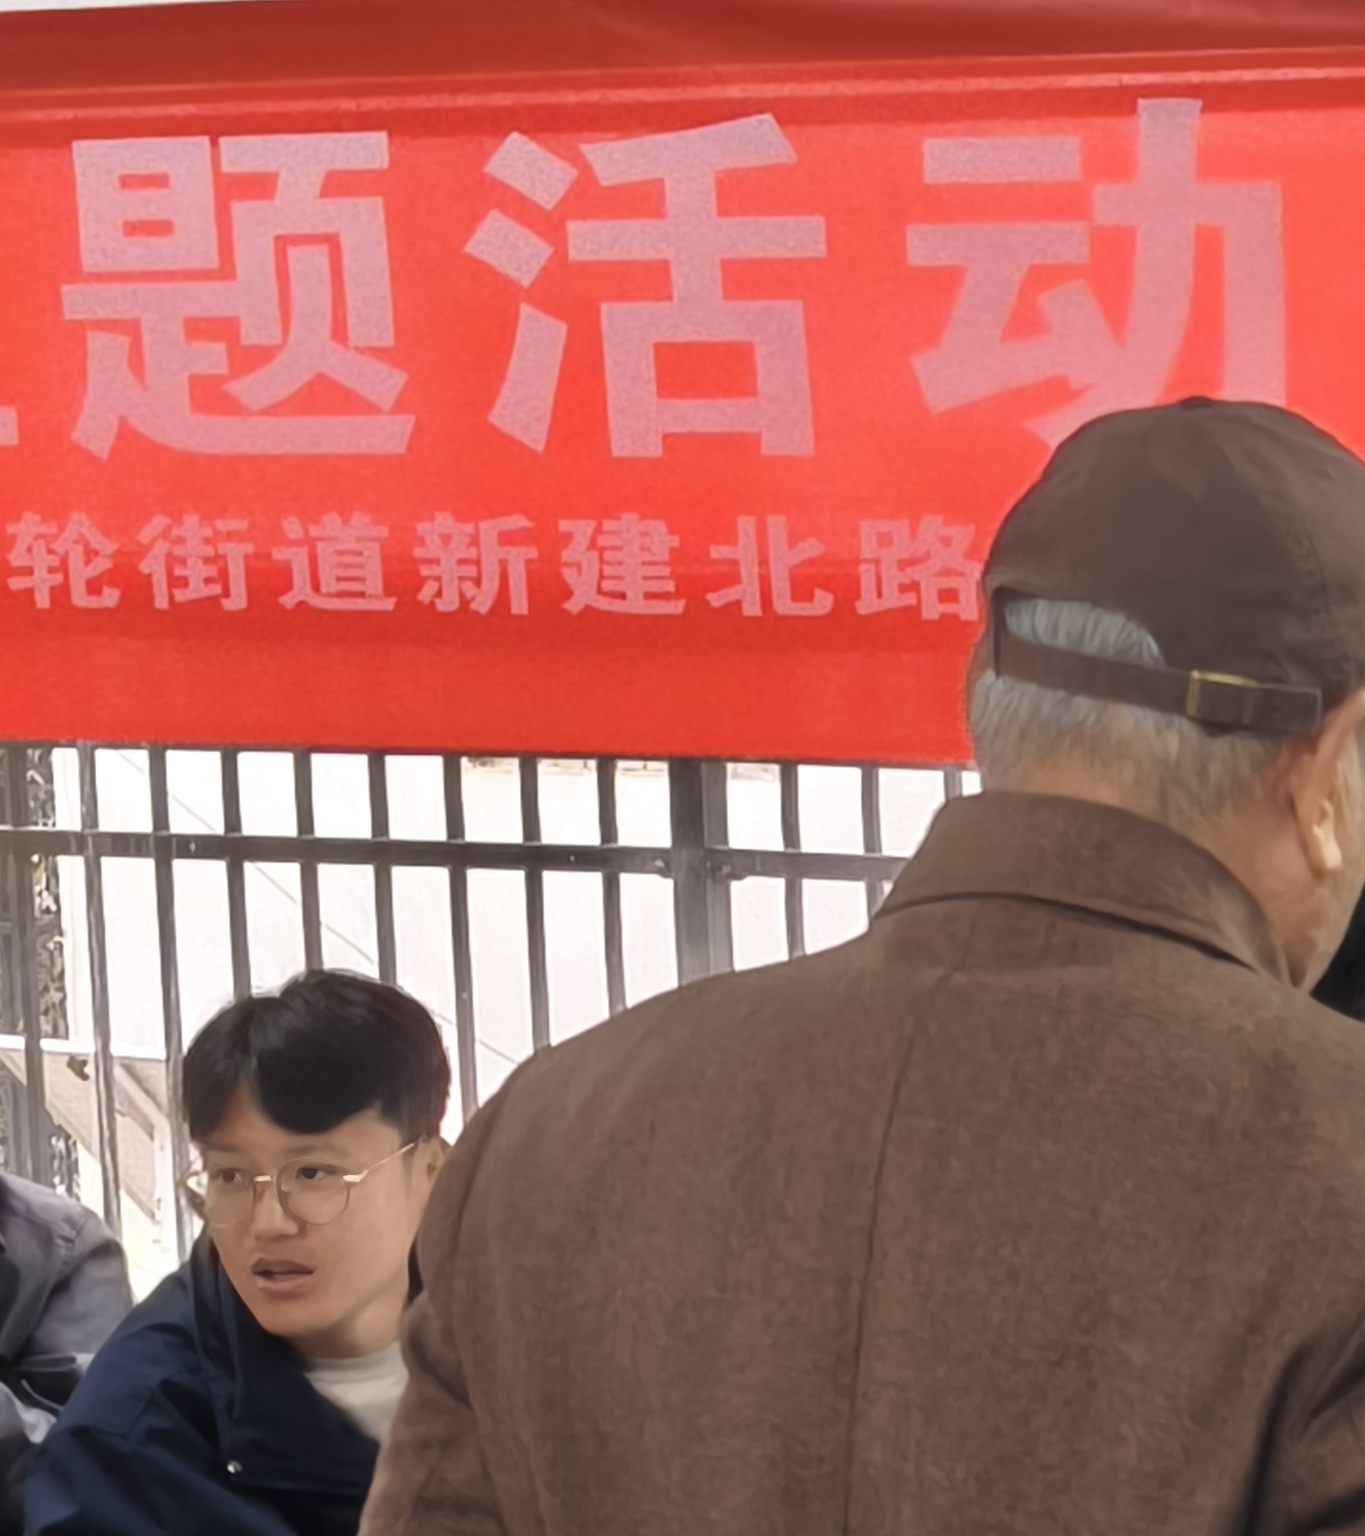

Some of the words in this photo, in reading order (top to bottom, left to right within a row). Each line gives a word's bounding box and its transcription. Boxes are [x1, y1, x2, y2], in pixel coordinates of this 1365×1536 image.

[0, 98, 1287, 460] 题活动
[7, 511, 983, 622] 轮街道新建北路
